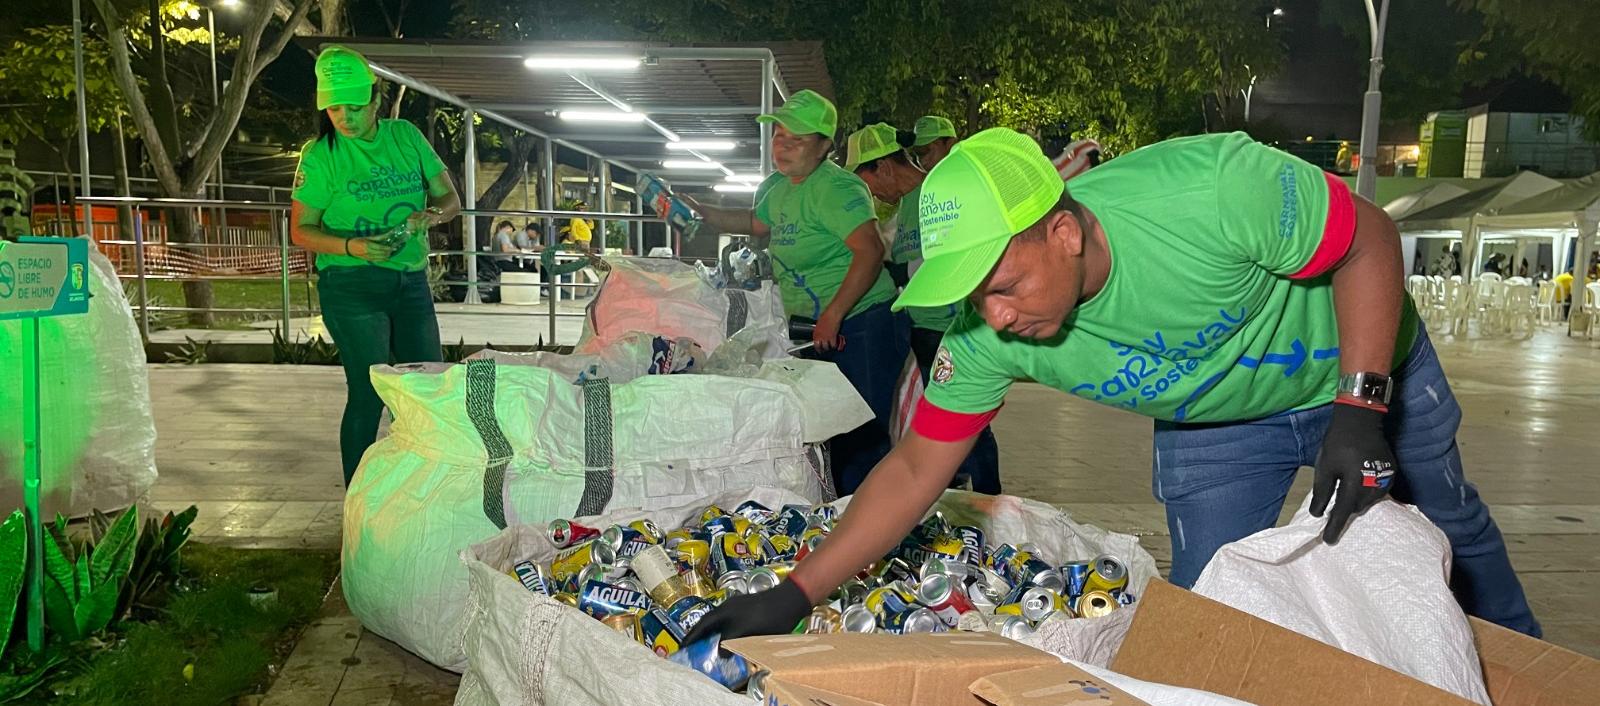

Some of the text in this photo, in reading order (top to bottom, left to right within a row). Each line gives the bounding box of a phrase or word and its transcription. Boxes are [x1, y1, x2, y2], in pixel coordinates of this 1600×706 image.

[920, 191, 936, 206] oy
[18, 257, 52, 270] ESPACIO
[18, 272, 41, 285] LIBRE
[18, 286, 30, 299] DE
[31, 286, 55, 298] HUMO
[587, 585, 649, 610] AGUILA
